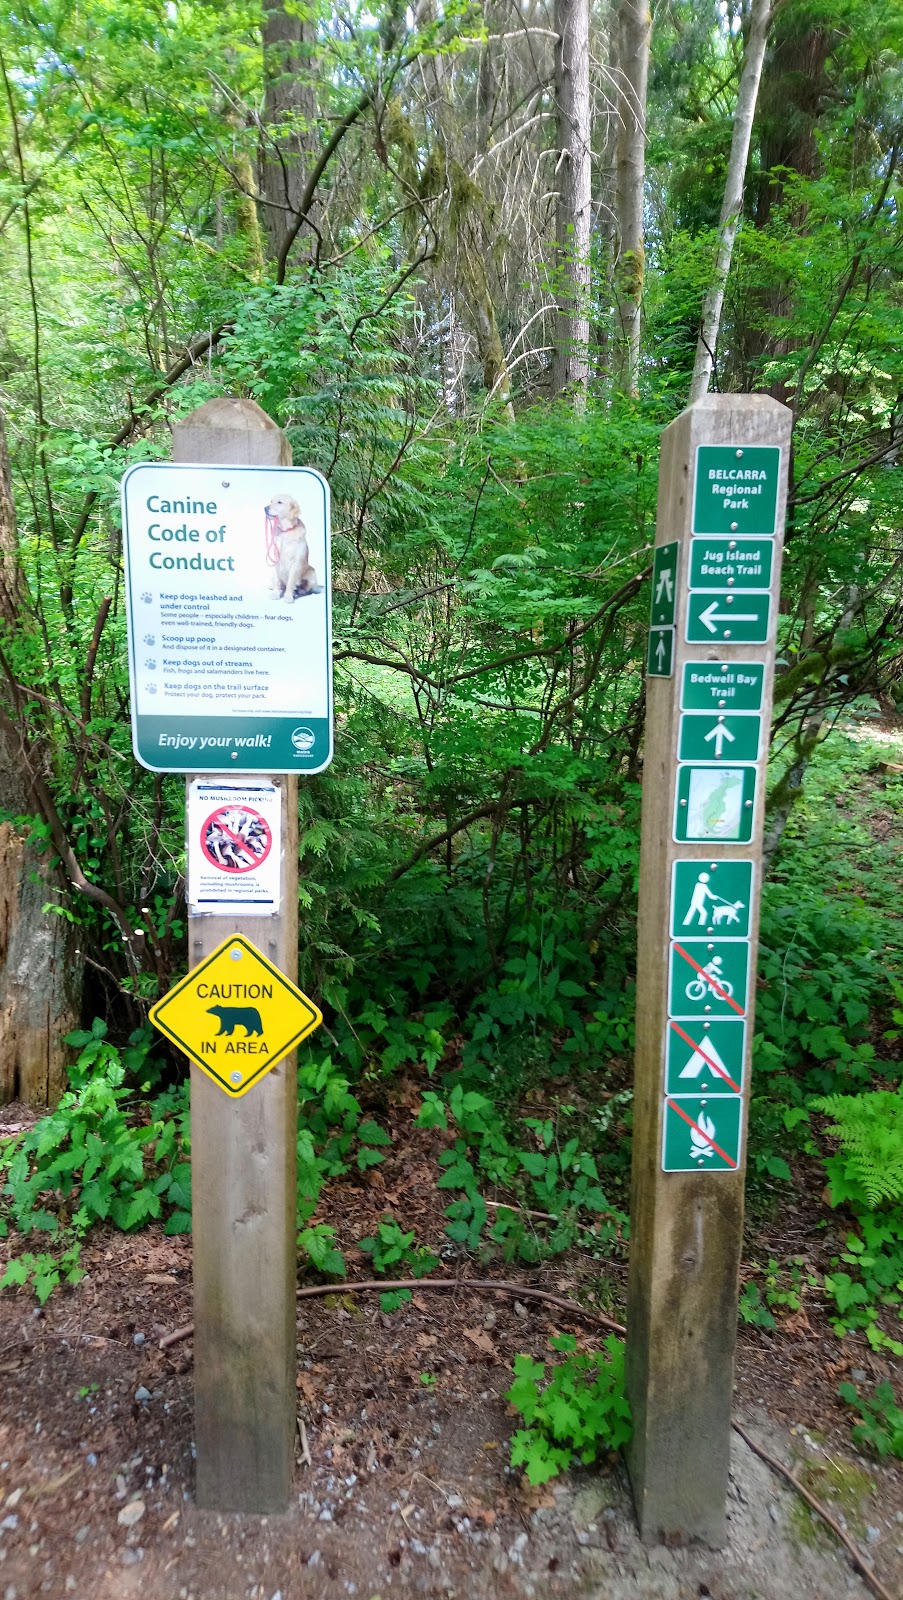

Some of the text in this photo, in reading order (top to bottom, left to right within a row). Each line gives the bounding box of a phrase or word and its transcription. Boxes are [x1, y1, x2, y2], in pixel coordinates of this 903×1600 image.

[708, 469, 767, 480] BELCARRA
[711, 483, 762, 497] Regional
[146, 495, 217, 514] Canine
[723, 498, 749, 509] Park
[148, 523, 227, 543] Code of
[149, 552, 235, 571] Conduct
[703, 550, 760, 562] Jug Island
[700, 564, 762, 575] Beach Trail
[159, 593, 178, 601] Keep
[180, 594, 198, 602] dogs
[162, 634, 184, 643] Scoop
[163, 659, 182, 667] Keep
[183, 659, 201, 668] dogs
[690, 673, 758, 687] Bedwell Bay
[164, 682, 183, 690] Keep
[184, 683, 202, 691] dogs
[710, 686, 736, 697] Trail
[158, 734, 272, 750] Enjoy your walk!
[196, 984, 273, 999] CAUTION
[201, 1041, 269, 1054] IN AREA
